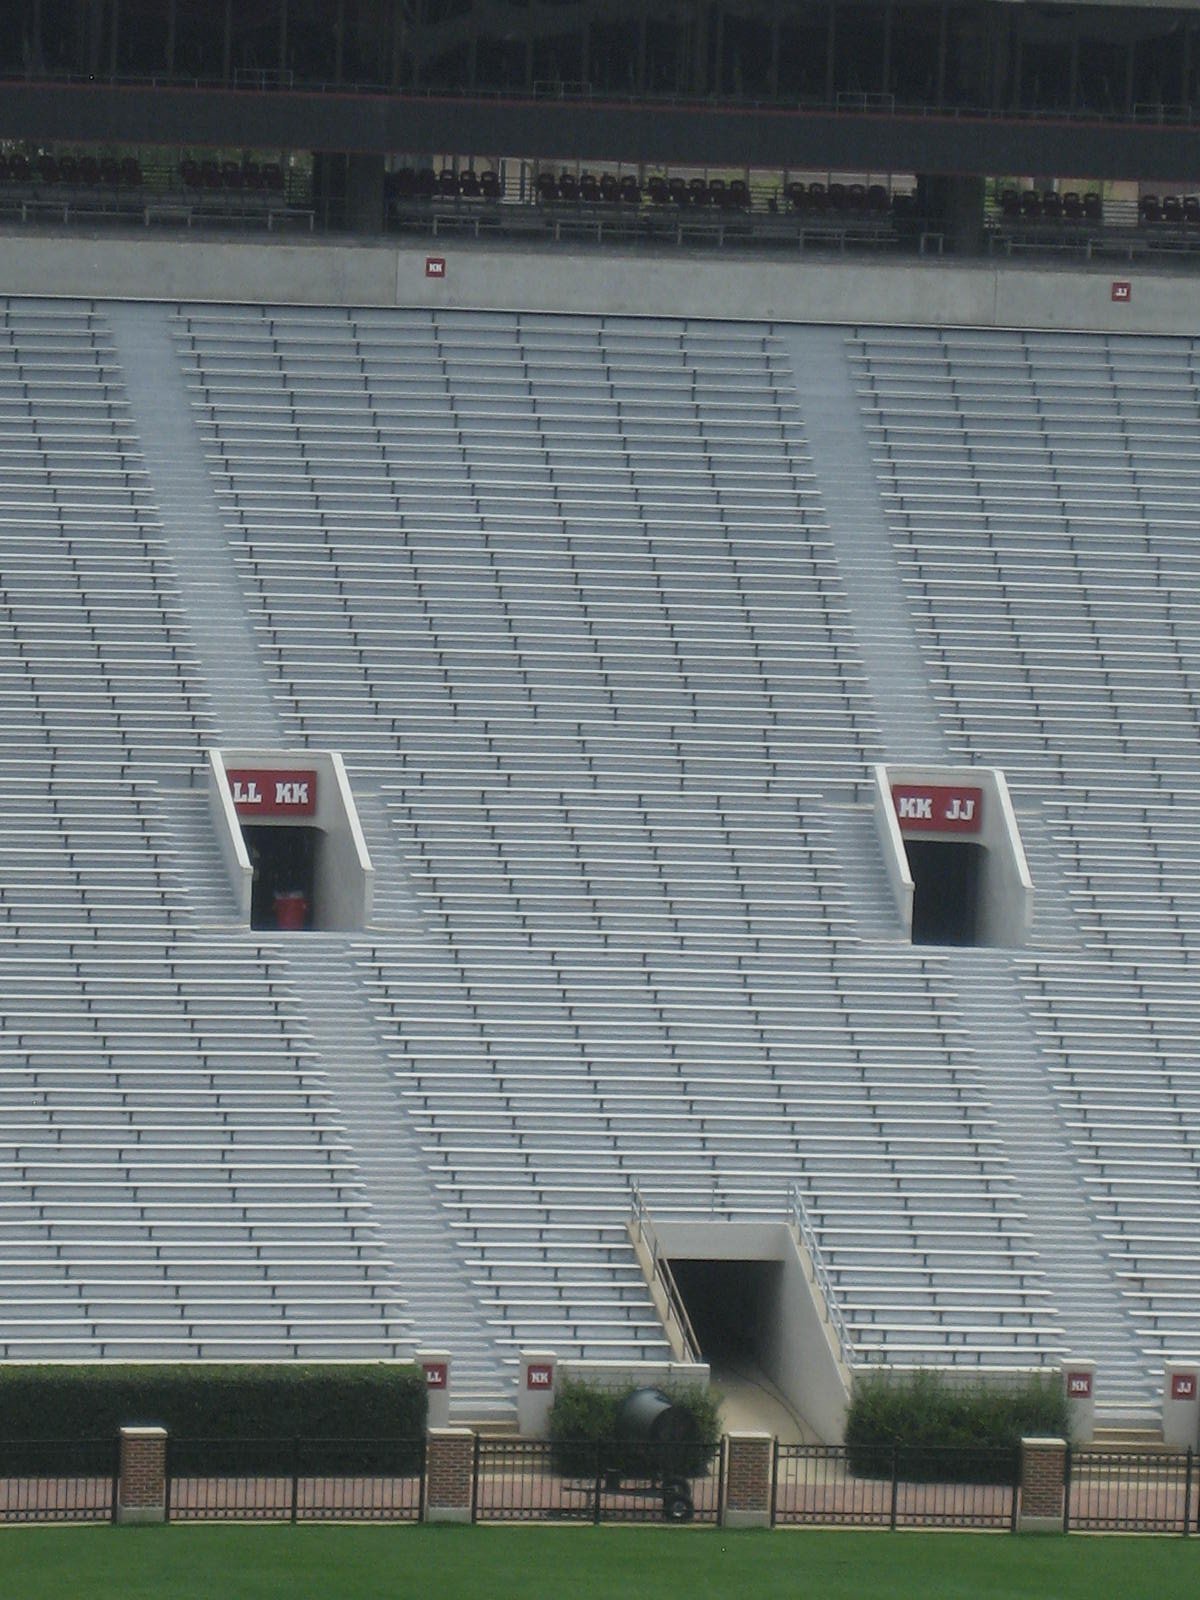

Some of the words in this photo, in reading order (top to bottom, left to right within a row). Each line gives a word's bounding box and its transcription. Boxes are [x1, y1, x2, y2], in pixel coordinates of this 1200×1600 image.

[233, 782, 262, 803] LL
[275, 783, 308, 804] KK
[899, 797, 933, 819] KK
[945, 799, 975, 820] JJ
[1176, 1381, 1191, 1393] JJ
